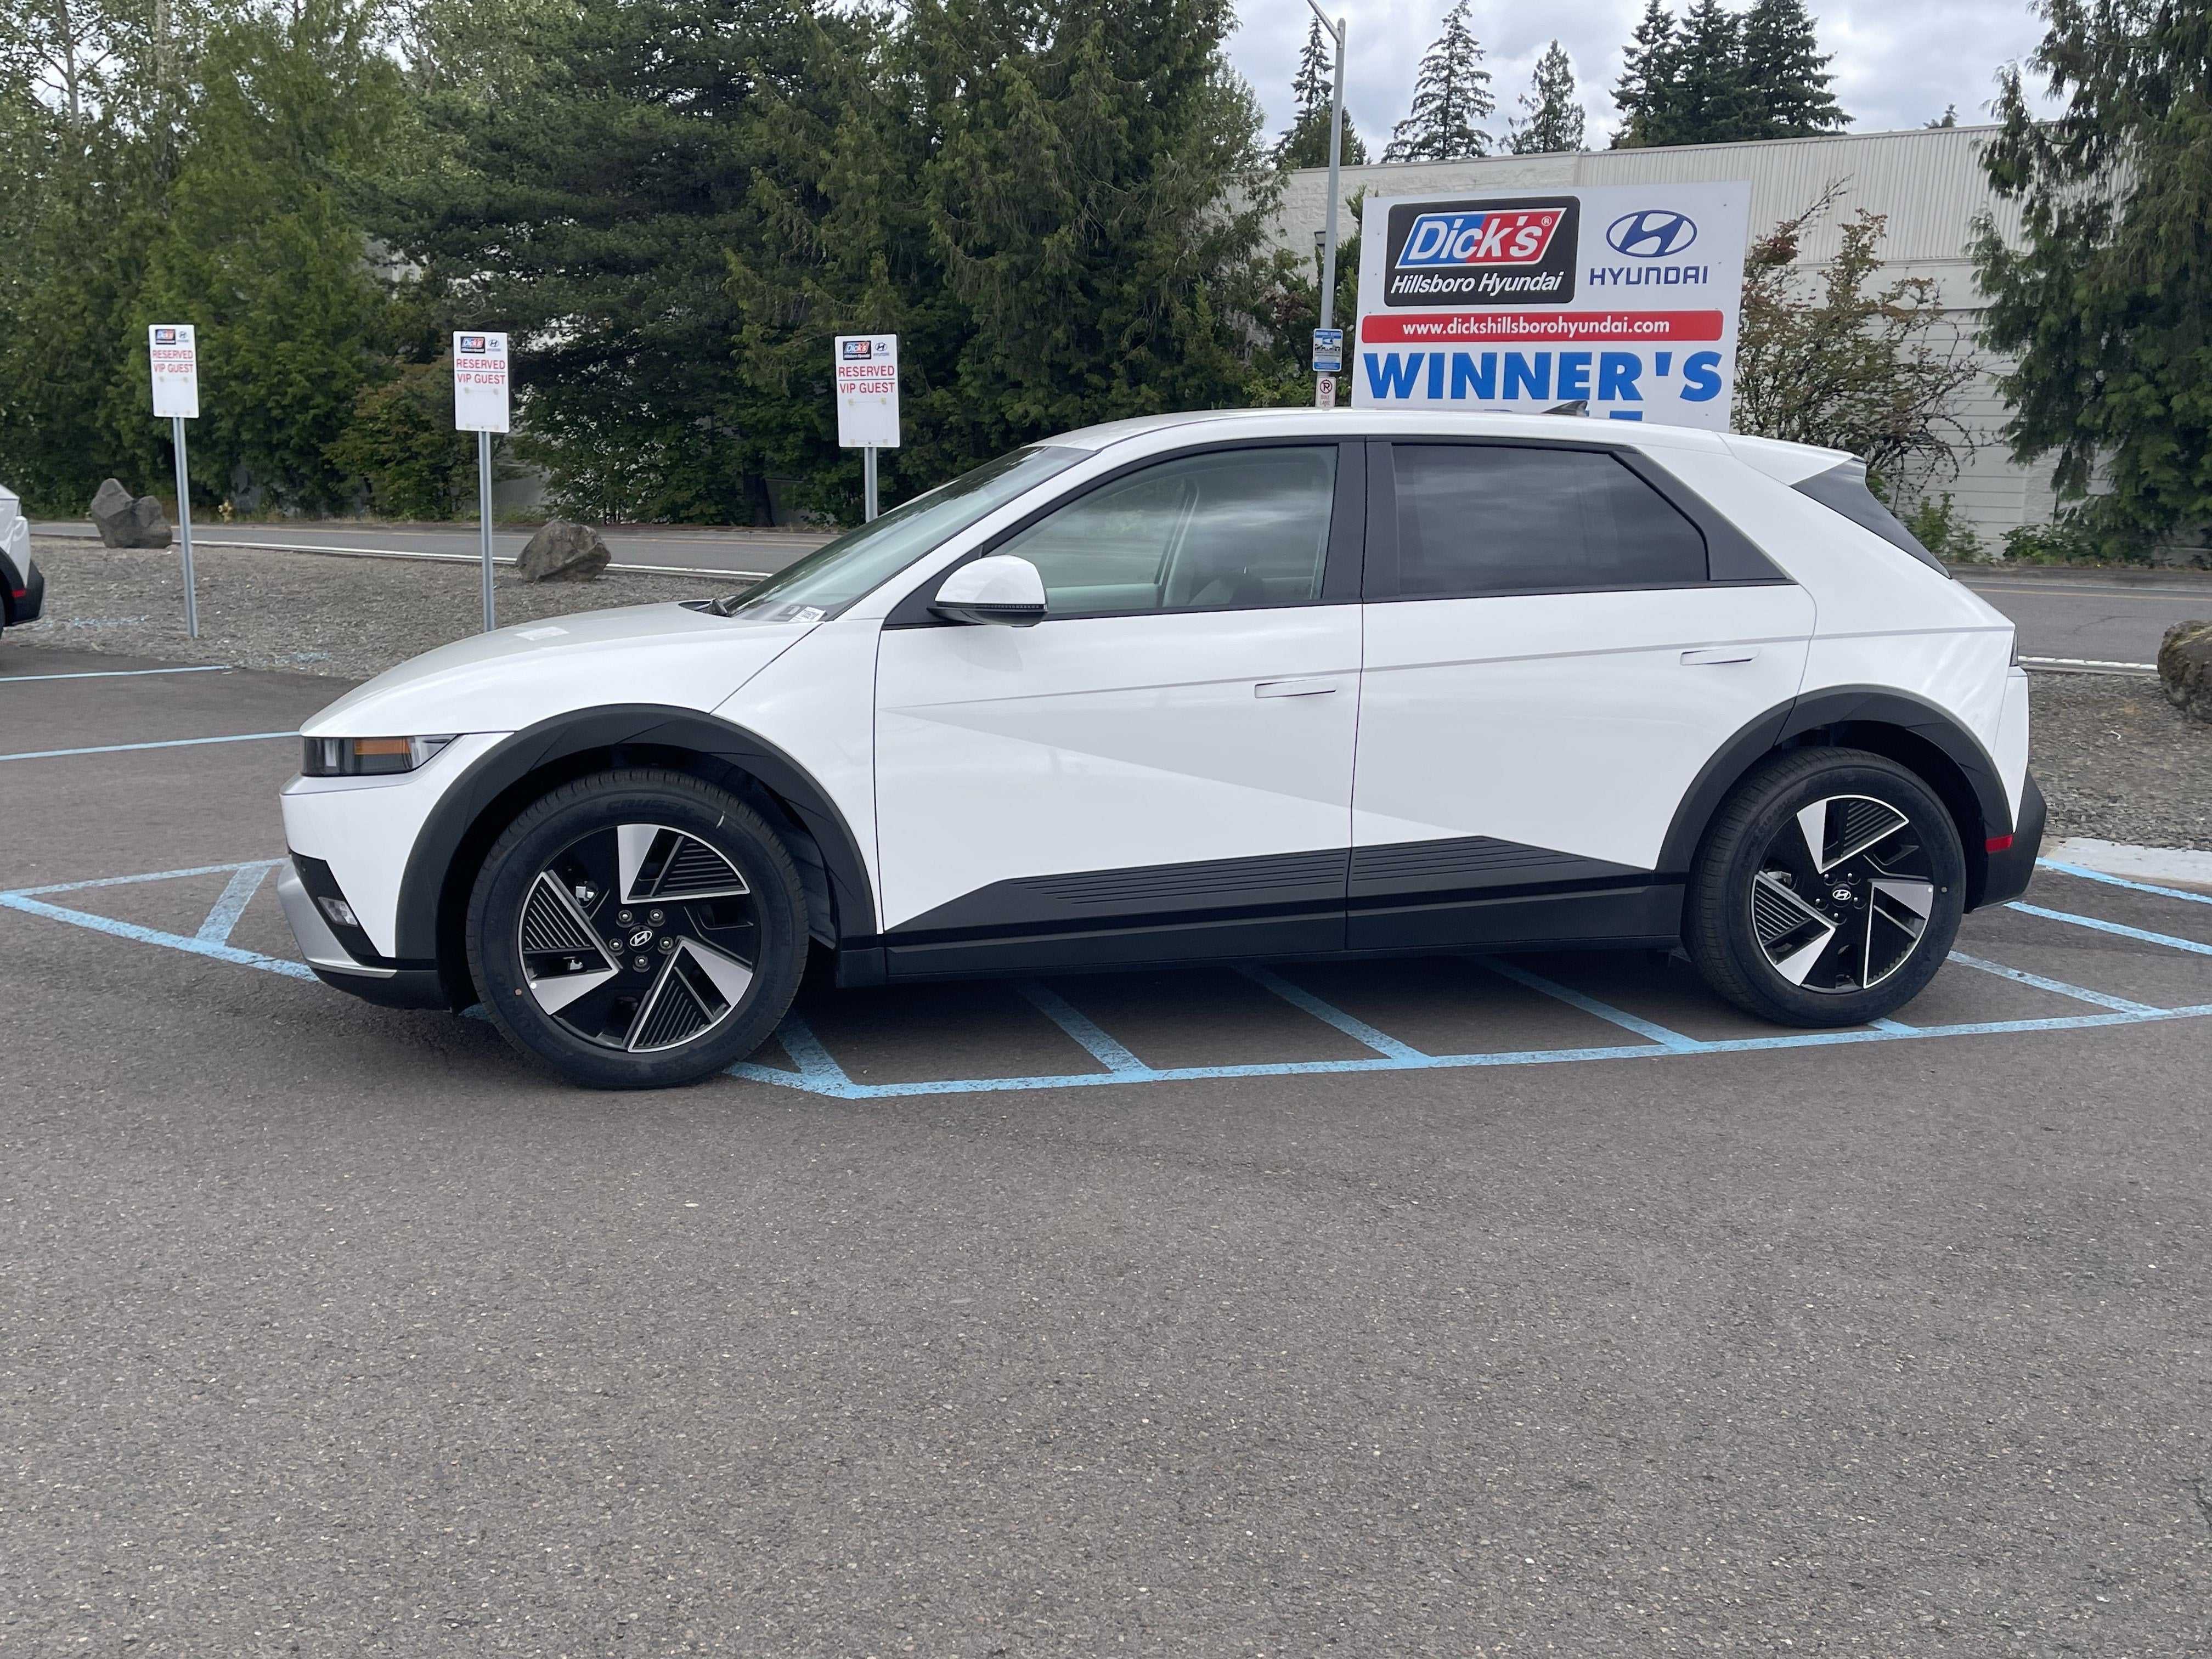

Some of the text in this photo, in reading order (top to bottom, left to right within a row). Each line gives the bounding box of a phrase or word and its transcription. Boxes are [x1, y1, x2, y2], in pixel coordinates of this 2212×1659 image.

[1408, 216, 1542, 260] Dick's
[1589, 266, 1708, 286] HYUNDAI
[1390, 271, 1565, 297] Hillsboro Hyundai
[1402, 315, 1670, 338] www.dickshillsborohyundai.com
[152, 349, 193, 359] RESERVED
[153, 363, 194, 373] VIP GUEST
[456, 358, 506, 370] RESERVED
[838, 365, 895, 377] RESERVED
[1363, 350, 1723, 402] WINNER'S
[457, 373, 506, 385] VIP GUEST
[839, 382, 895, 394] VIP GUEST
